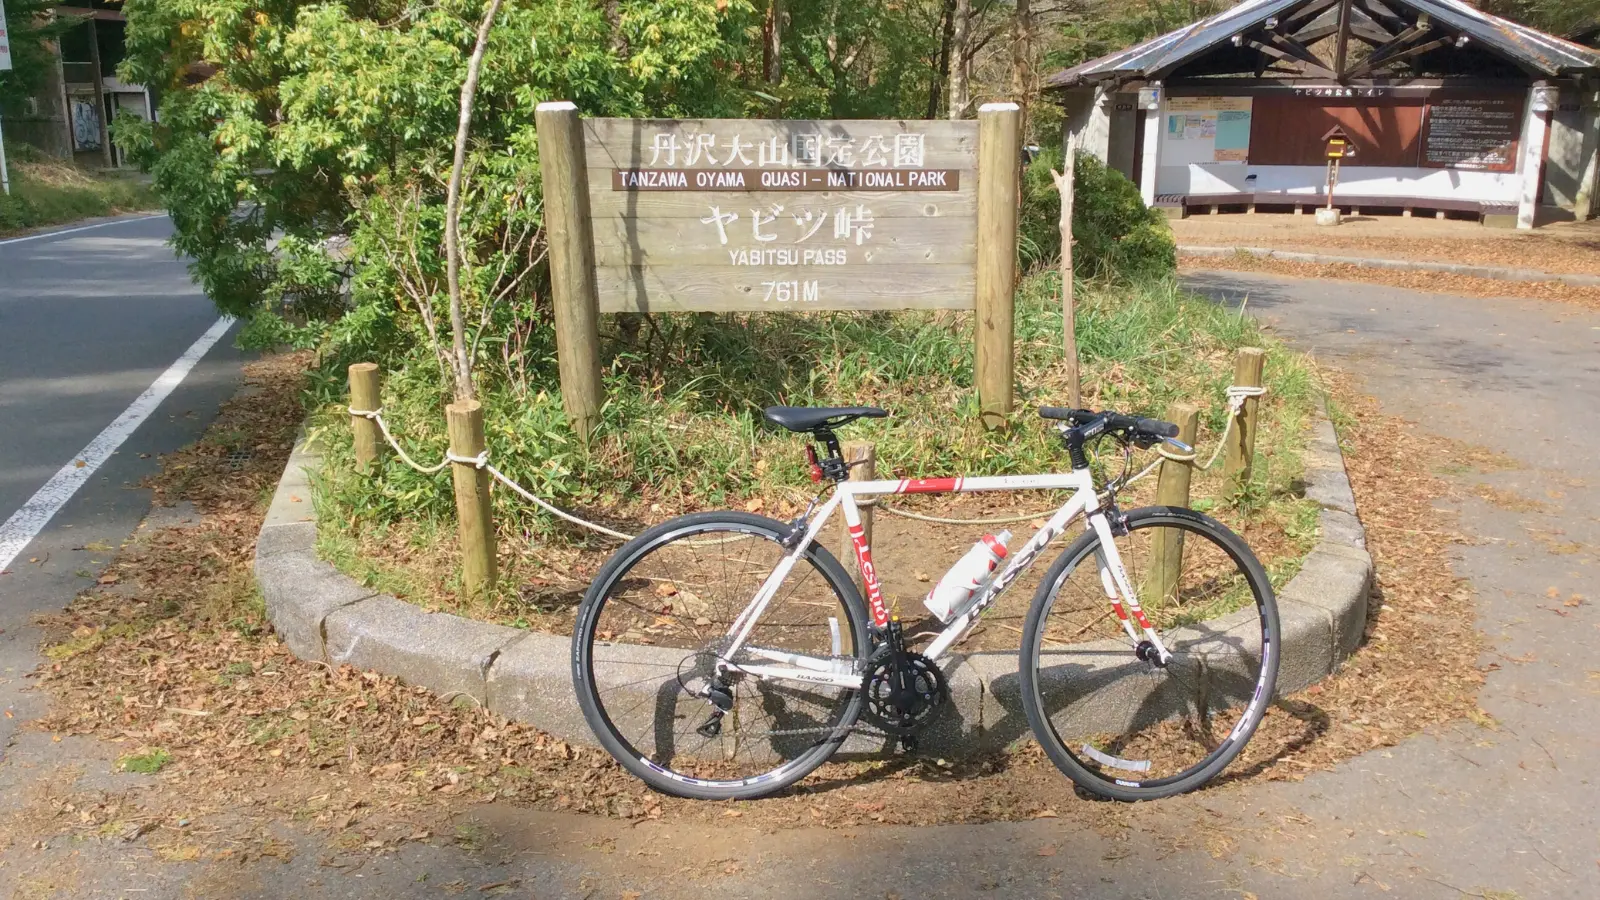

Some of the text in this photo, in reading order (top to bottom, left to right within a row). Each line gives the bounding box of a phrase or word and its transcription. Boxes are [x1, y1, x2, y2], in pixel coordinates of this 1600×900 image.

[649, 133, 925, 167] 丹沢大山国定公園
[619, 171, 688, 187] TANZAWA
[696, 171, 746, 187] OYAMA
[908, 171, 947, 186] PARK
[700, 203, 874, 246] ヤビツ峠
[728, 249, 847, 266] YABITSU PASS
